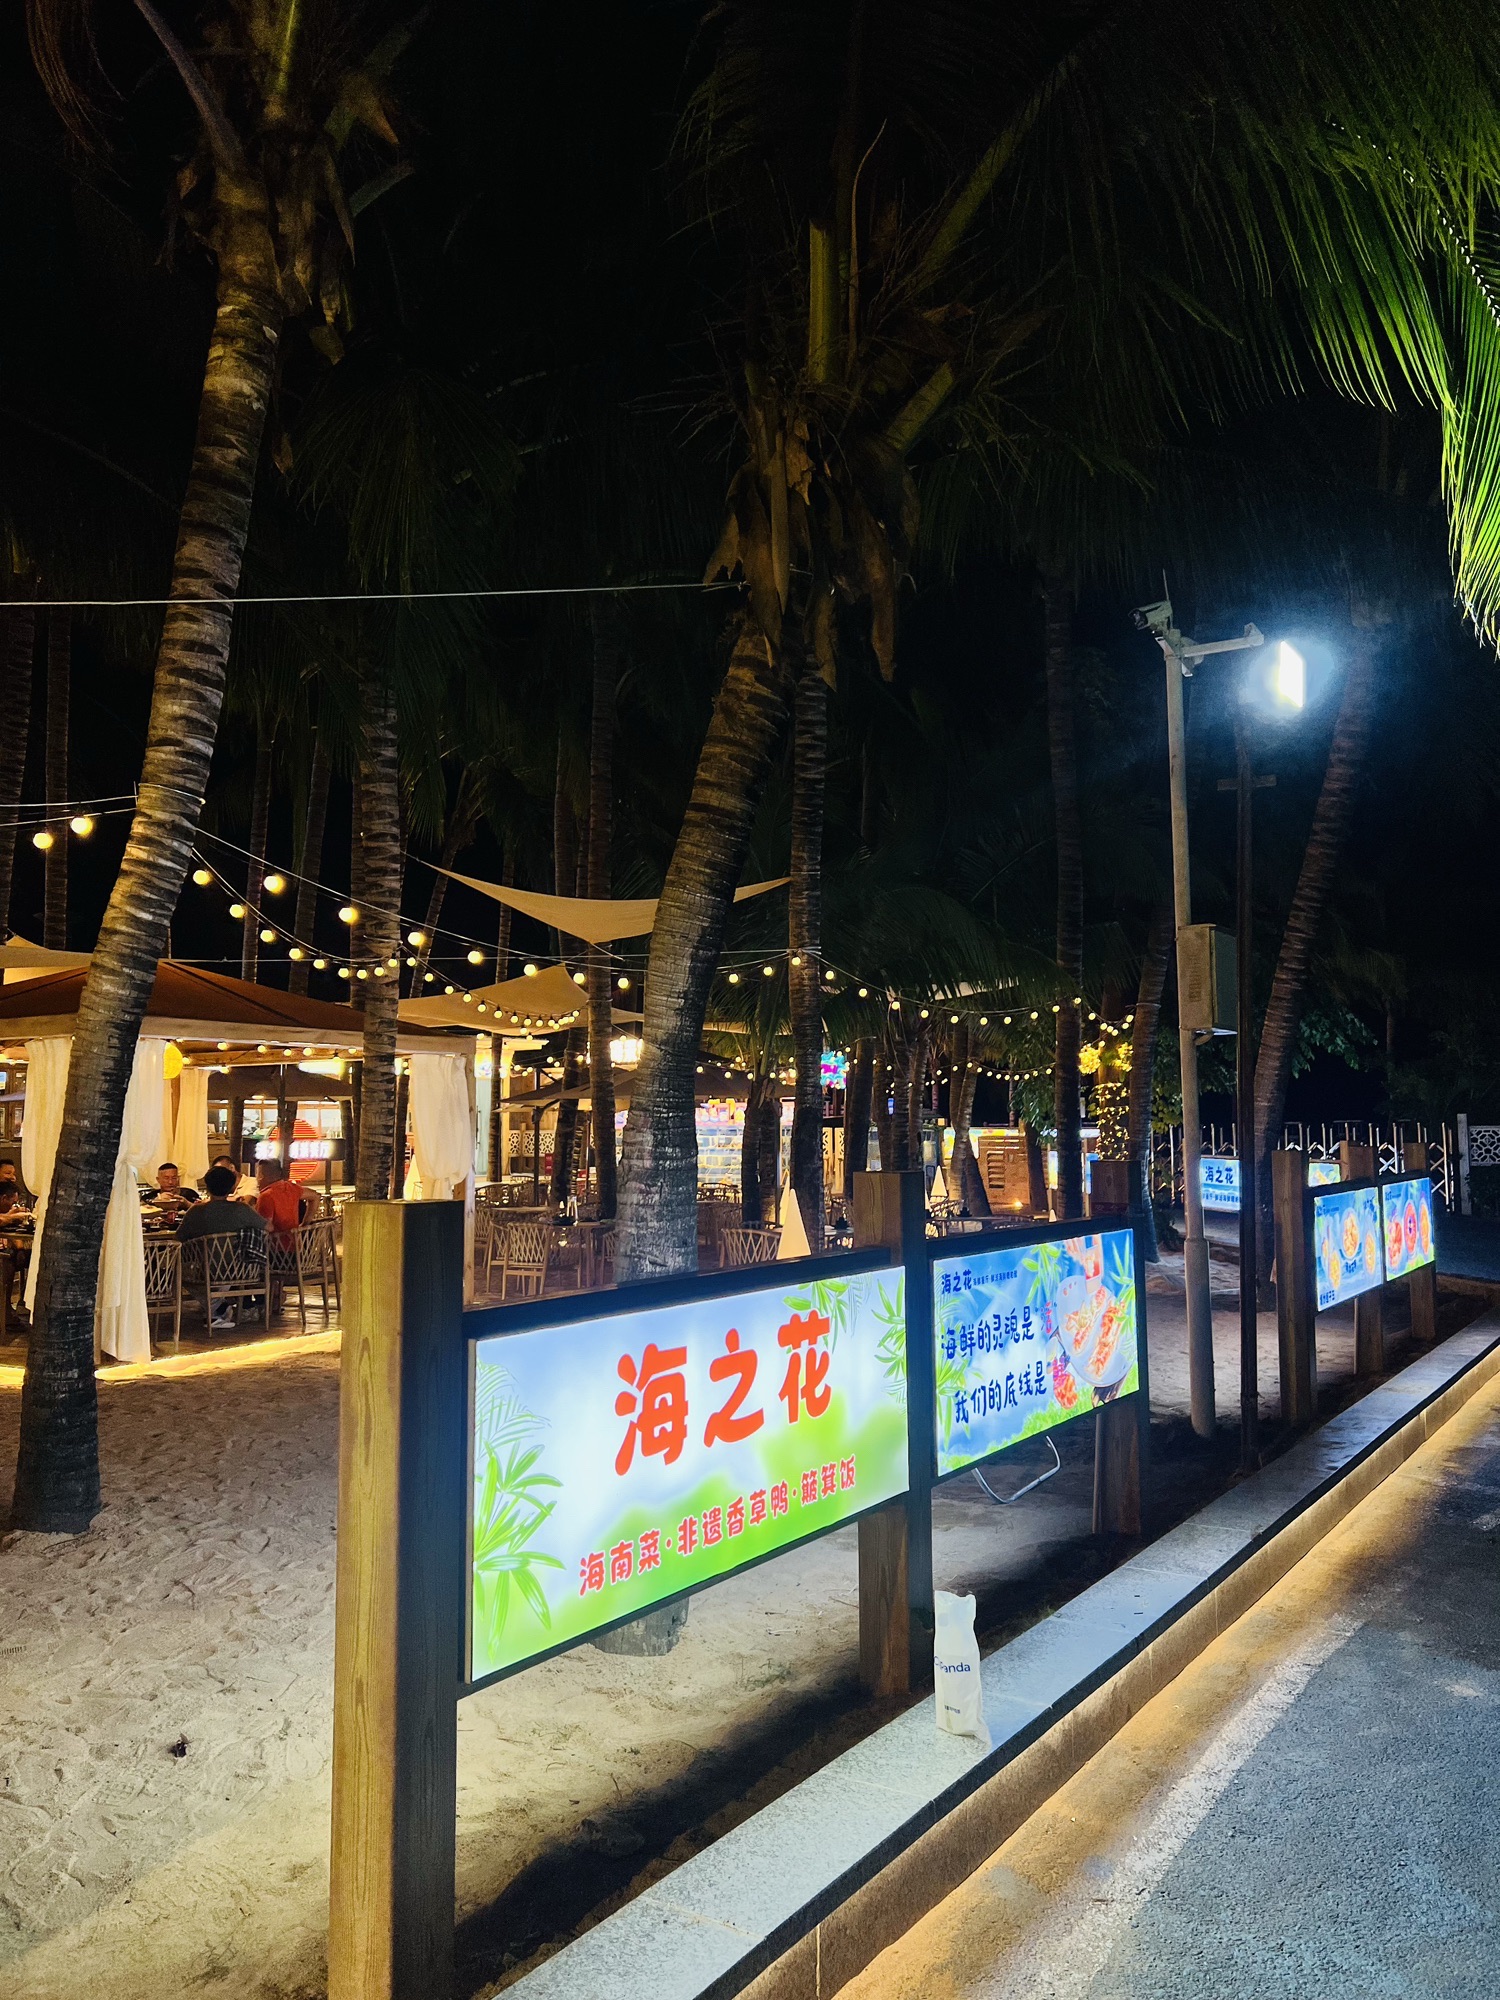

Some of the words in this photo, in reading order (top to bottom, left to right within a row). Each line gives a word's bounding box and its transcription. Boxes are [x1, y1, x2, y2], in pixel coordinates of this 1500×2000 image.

[1205, 1166, 1234, 1184] 海之花
[942, 1269, 972, 1294] 海之花
[941, 1306, 1034, 1359] 海鲜的灵魂是
[614, 1309, 832, 1477] 海之花
[954, 1361, 1047, 1423] 我们的底线是
